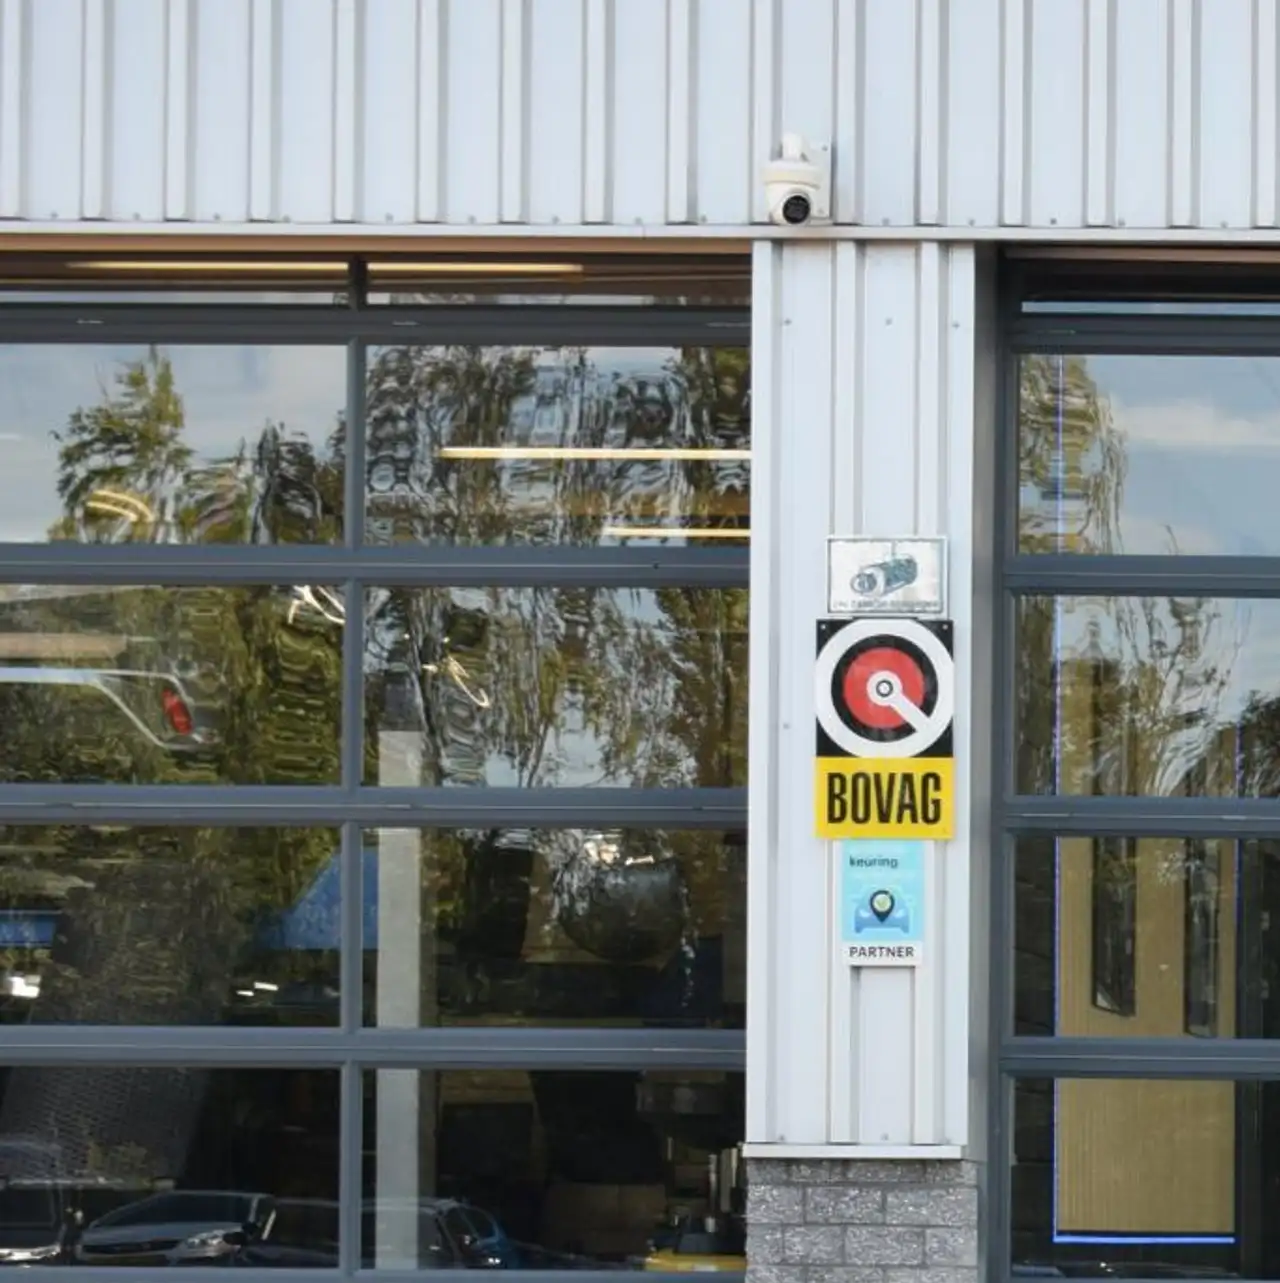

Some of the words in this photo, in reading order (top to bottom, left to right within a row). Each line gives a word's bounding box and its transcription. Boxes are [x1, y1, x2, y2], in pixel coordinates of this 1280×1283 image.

[827, 771, 942, 825] BOVAG
[849, 855, 899, 869] keuring
[849, 946, 914, 957] PARTNER
